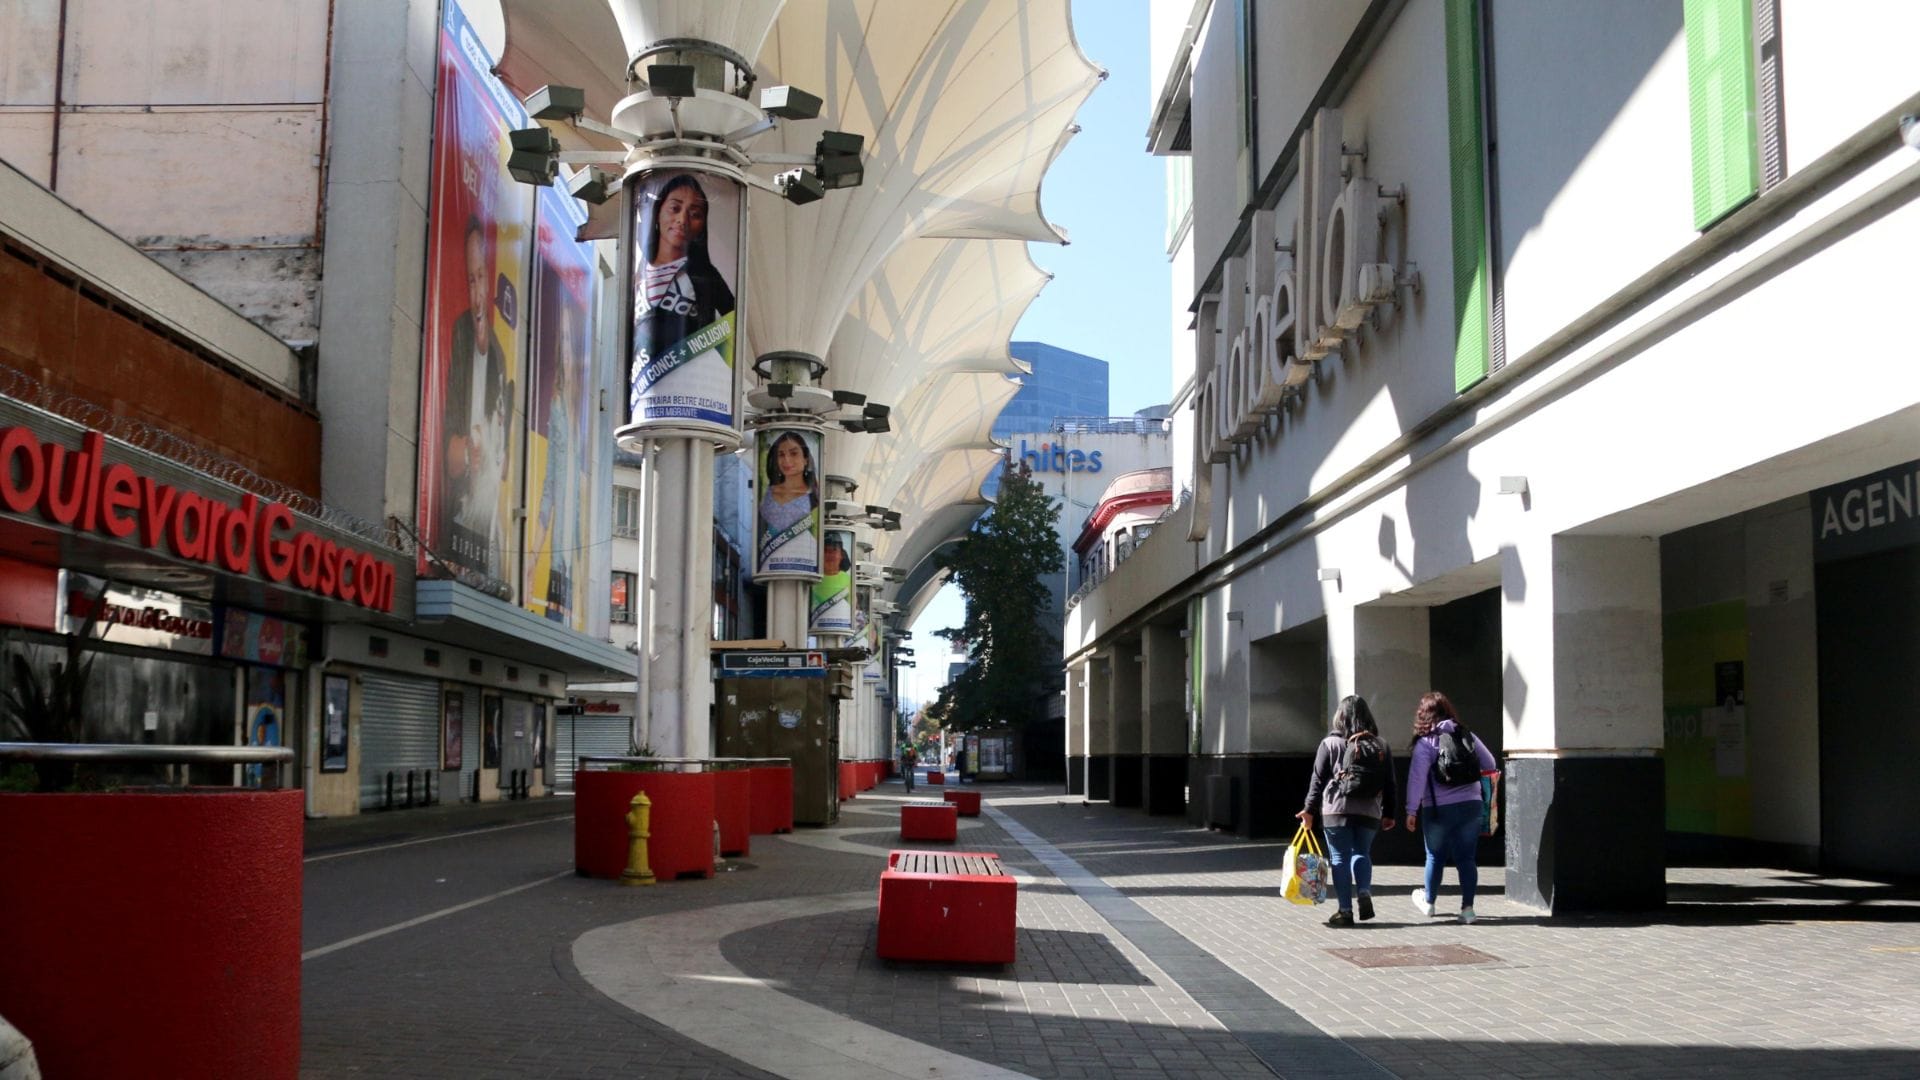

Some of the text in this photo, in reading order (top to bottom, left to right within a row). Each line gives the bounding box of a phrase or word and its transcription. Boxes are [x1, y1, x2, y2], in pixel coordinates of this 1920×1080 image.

[646, 350, 681, 381] CONCE
[686, 320, 731, 354] INCLUSIVO
[1021, 440, 1103, 473] hites
[1820, 469, 1920, 540] AGEN
[258, 502, 397, 612] Gascon
